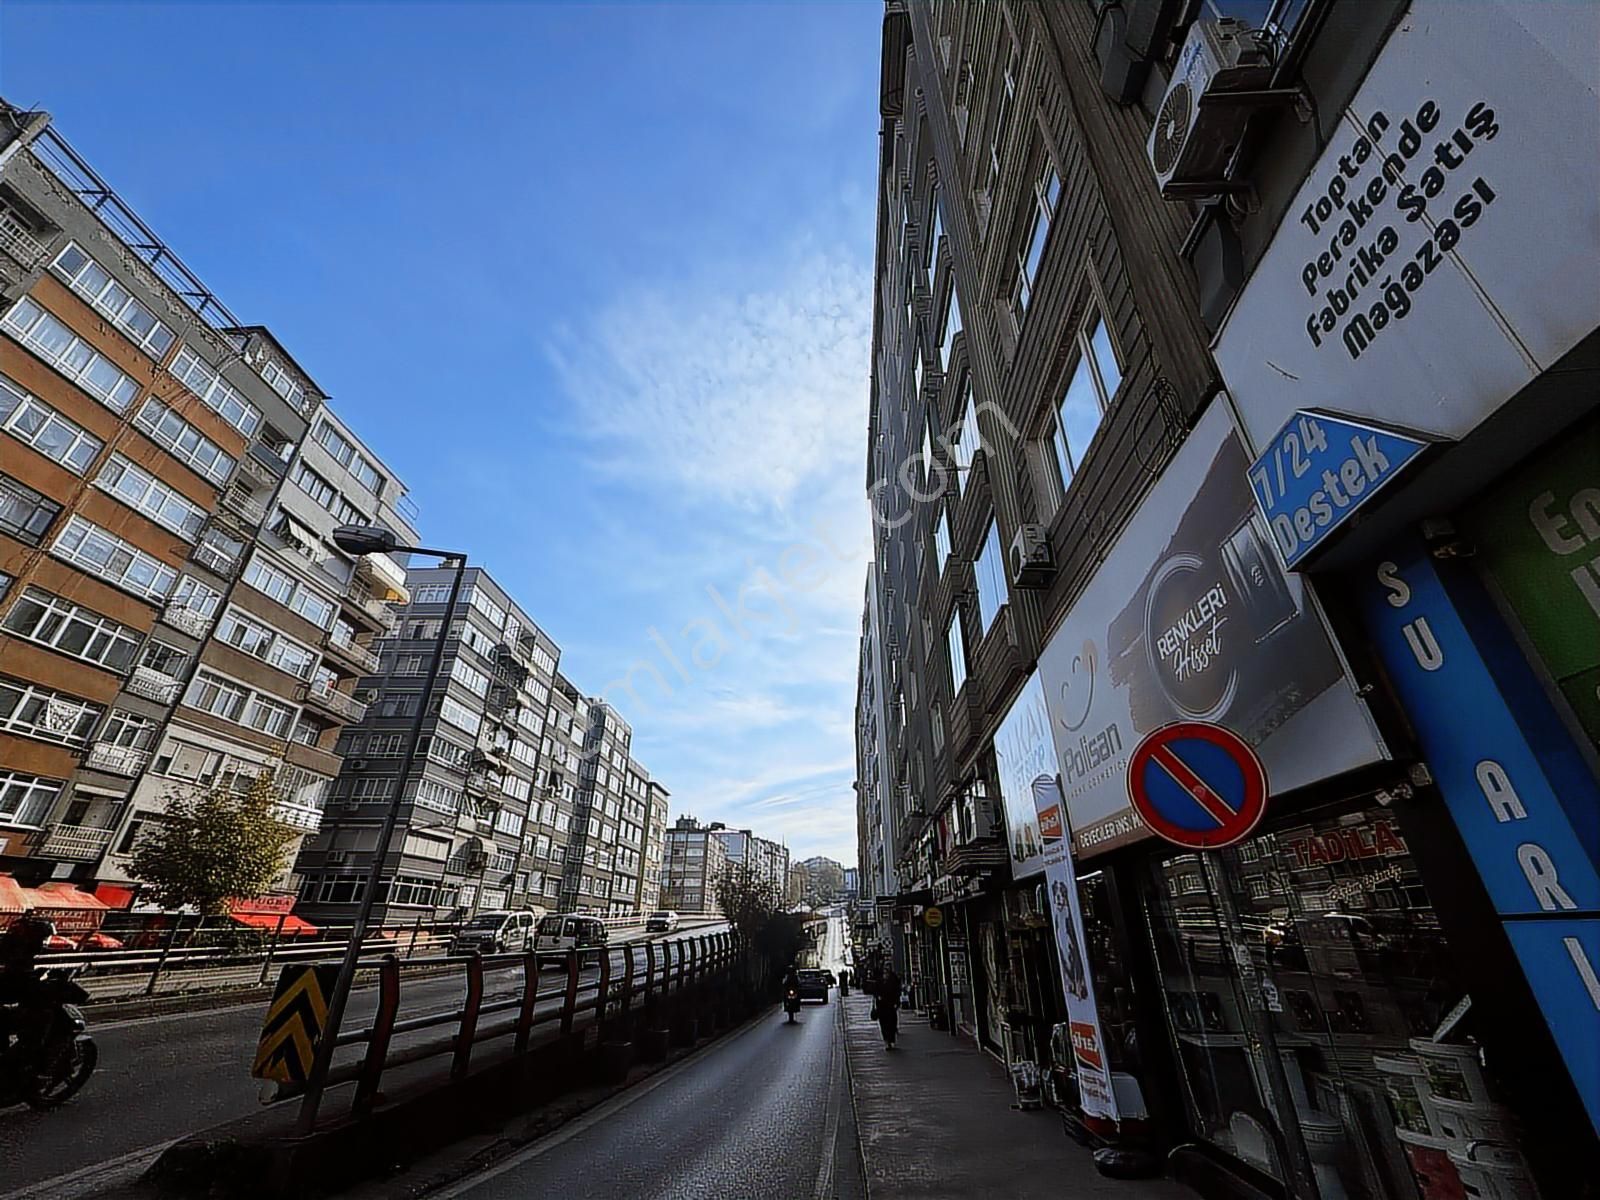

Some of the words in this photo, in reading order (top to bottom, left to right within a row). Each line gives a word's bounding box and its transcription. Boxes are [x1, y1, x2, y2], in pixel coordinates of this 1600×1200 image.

[1300, 110, 1390, 236] Toptan
[1301, 99, 1441, 297] Perakende
[1306, 226, 1399, 348] Fabrika
[1397, 101, 1500, 223] Satış
[1341, 176, 1497, 360] Mağazası
[1252, 416, 1329, 510] 7/24
[1272, 435, 1390, 553] Destek
[1173, 616, 1229, 682] Hisset
[1063, 722, 1122, 784] Polisan
